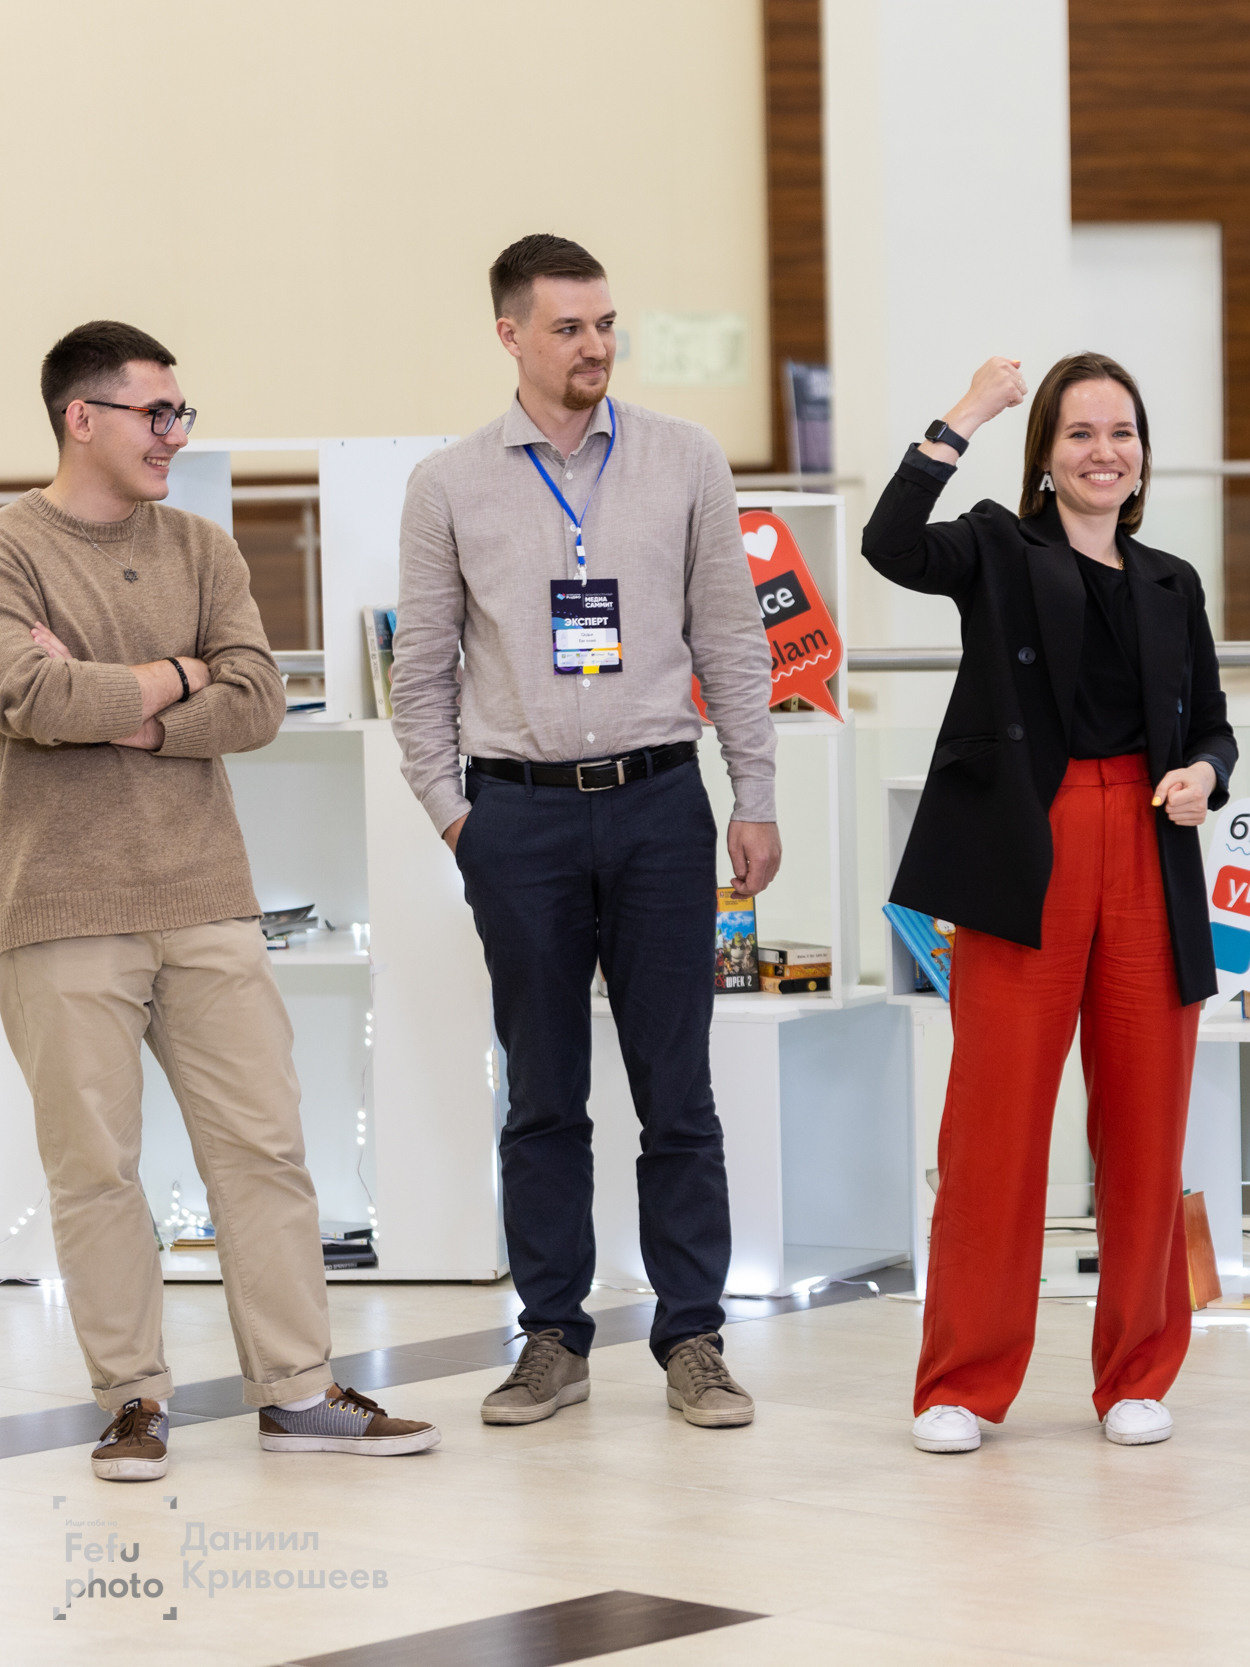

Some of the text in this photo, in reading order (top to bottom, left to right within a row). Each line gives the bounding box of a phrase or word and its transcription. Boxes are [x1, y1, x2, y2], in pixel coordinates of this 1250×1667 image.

[585, 601, 614, 609] САММИТ
[564, 617, 609, 627] ЭКСПЕРТ
[725, 976, 746, 988] ШРЕК
[747, 975, 753, 987] 2
